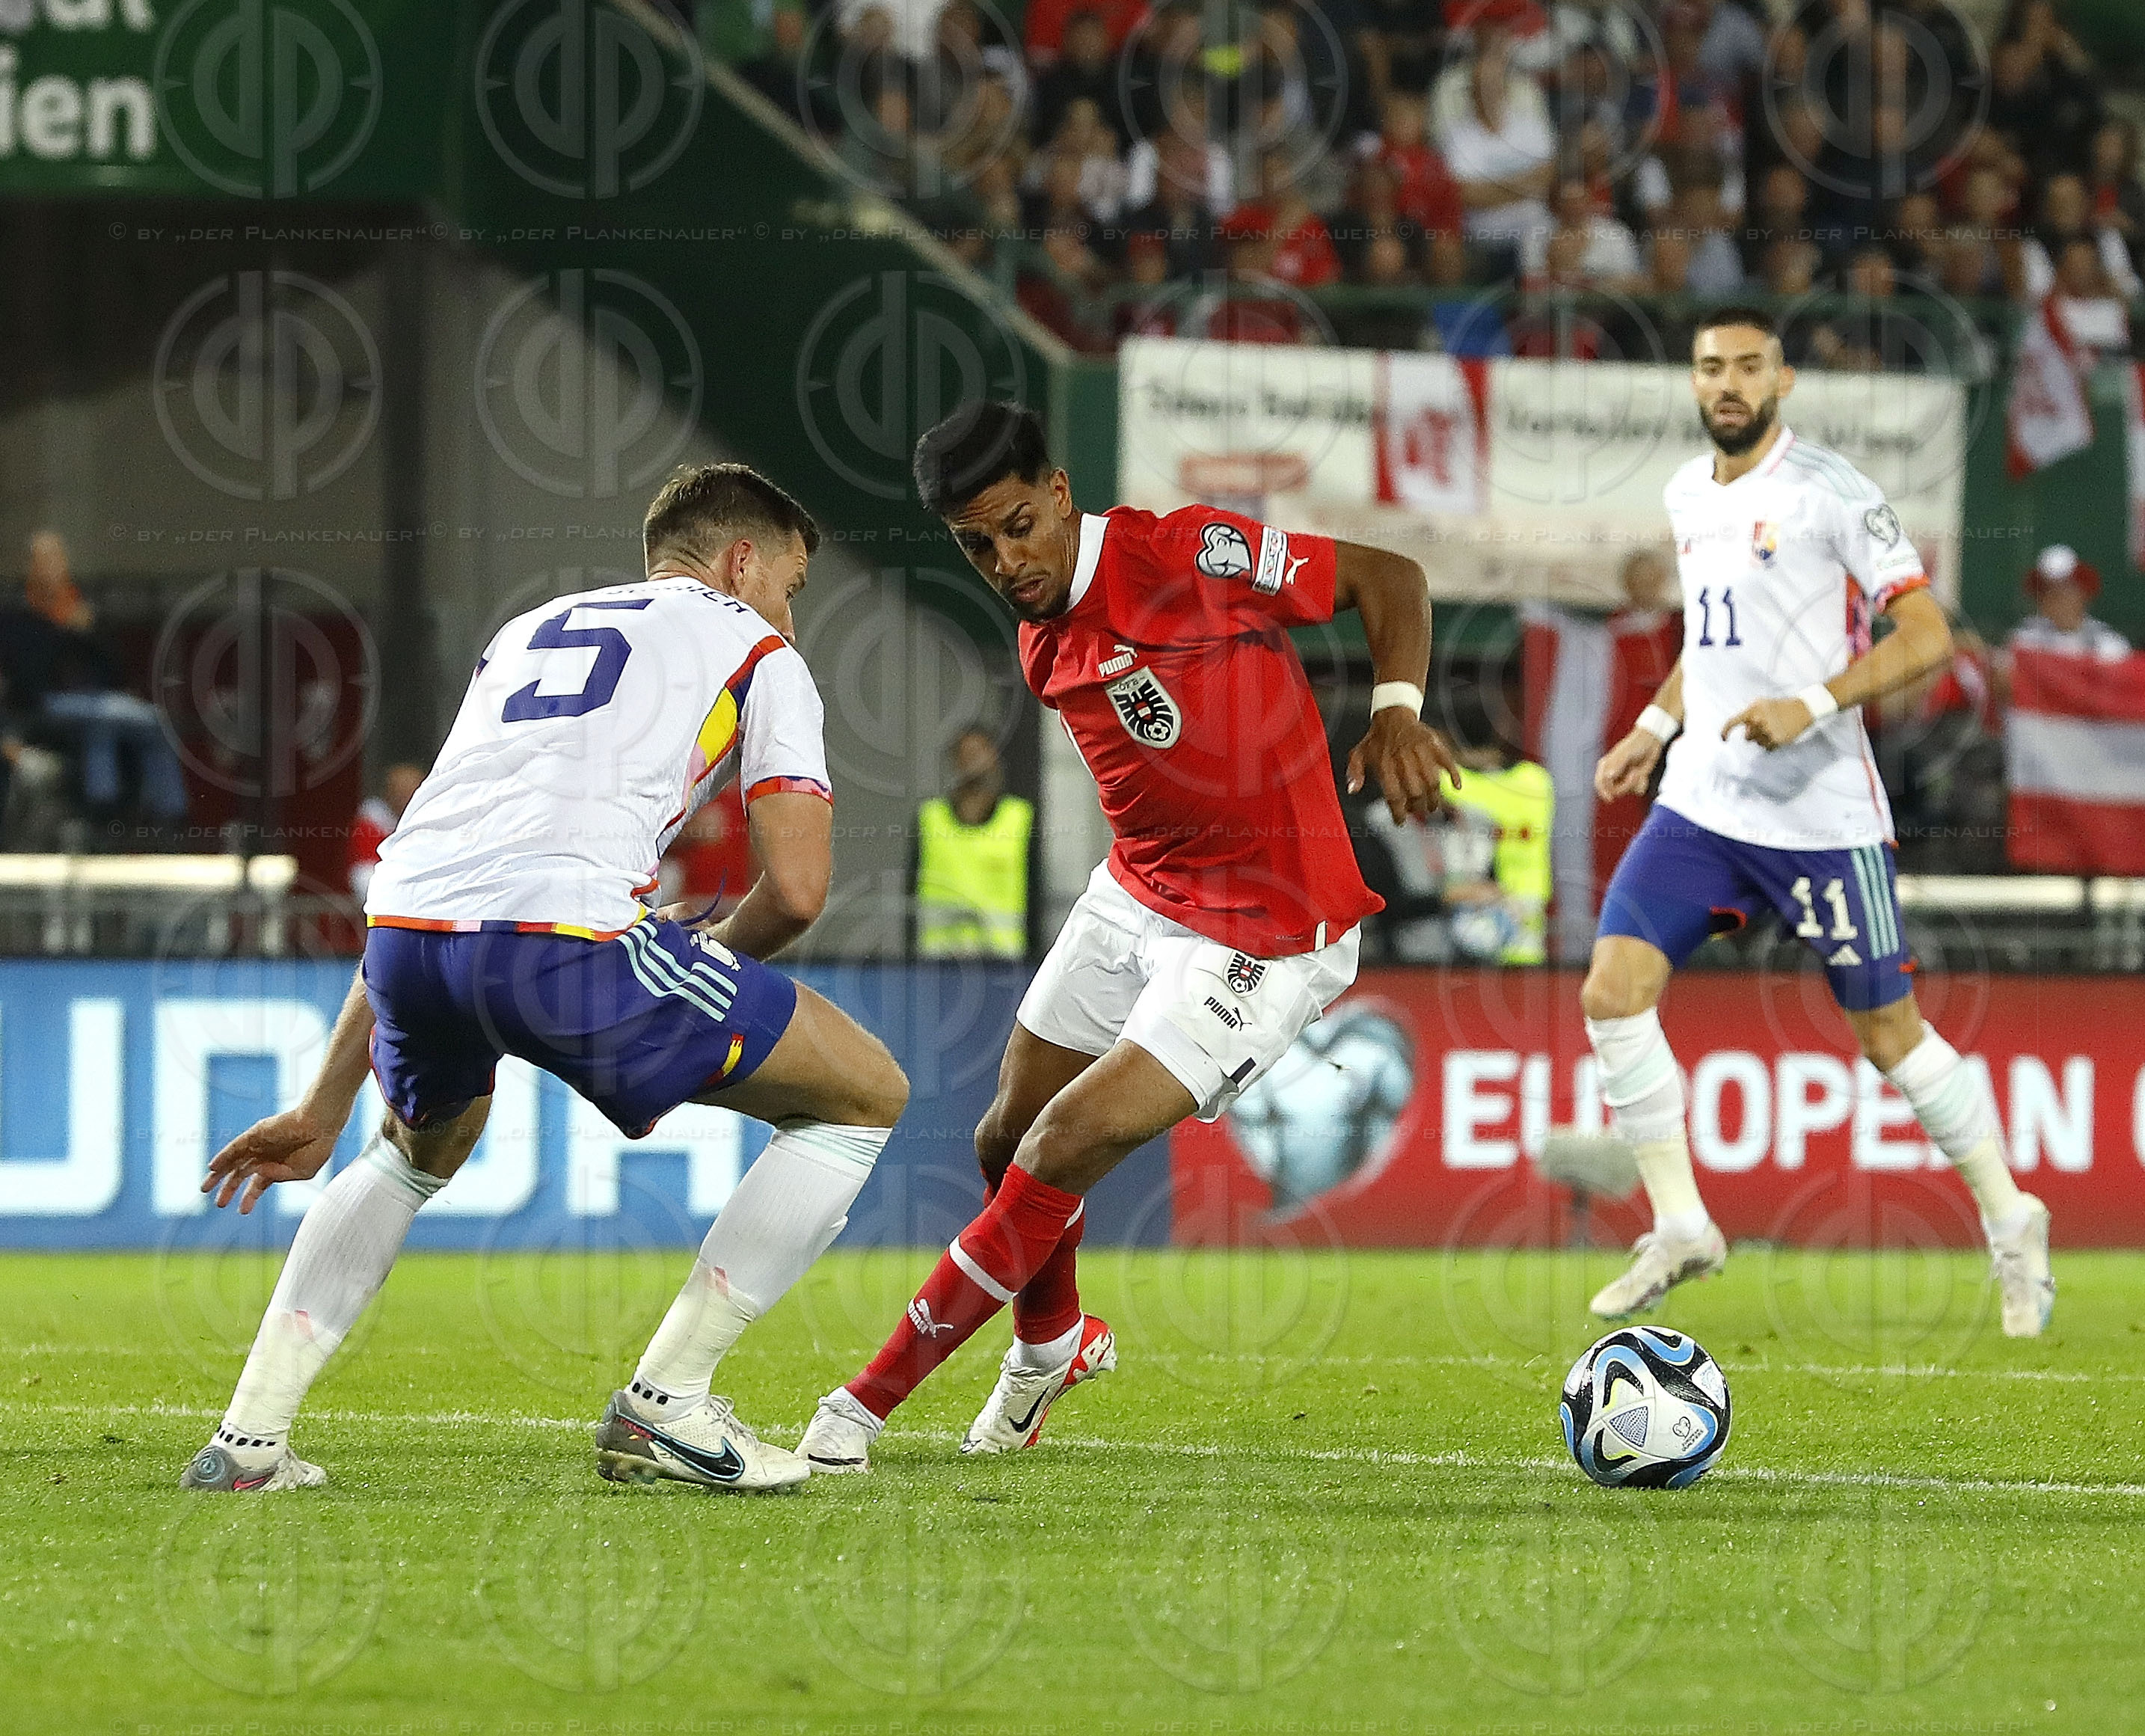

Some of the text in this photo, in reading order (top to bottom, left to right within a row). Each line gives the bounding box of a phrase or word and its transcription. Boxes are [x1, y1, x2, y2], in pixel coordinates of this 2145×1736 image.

[1698, 586, 1742, 647] 11
[502, 598, 654, 723] 5
[1098, 653, 1133, 678] PUMA
[1790, 877, 1858, 940] 11
[1203, 996, 1238, 1029] PUMA
